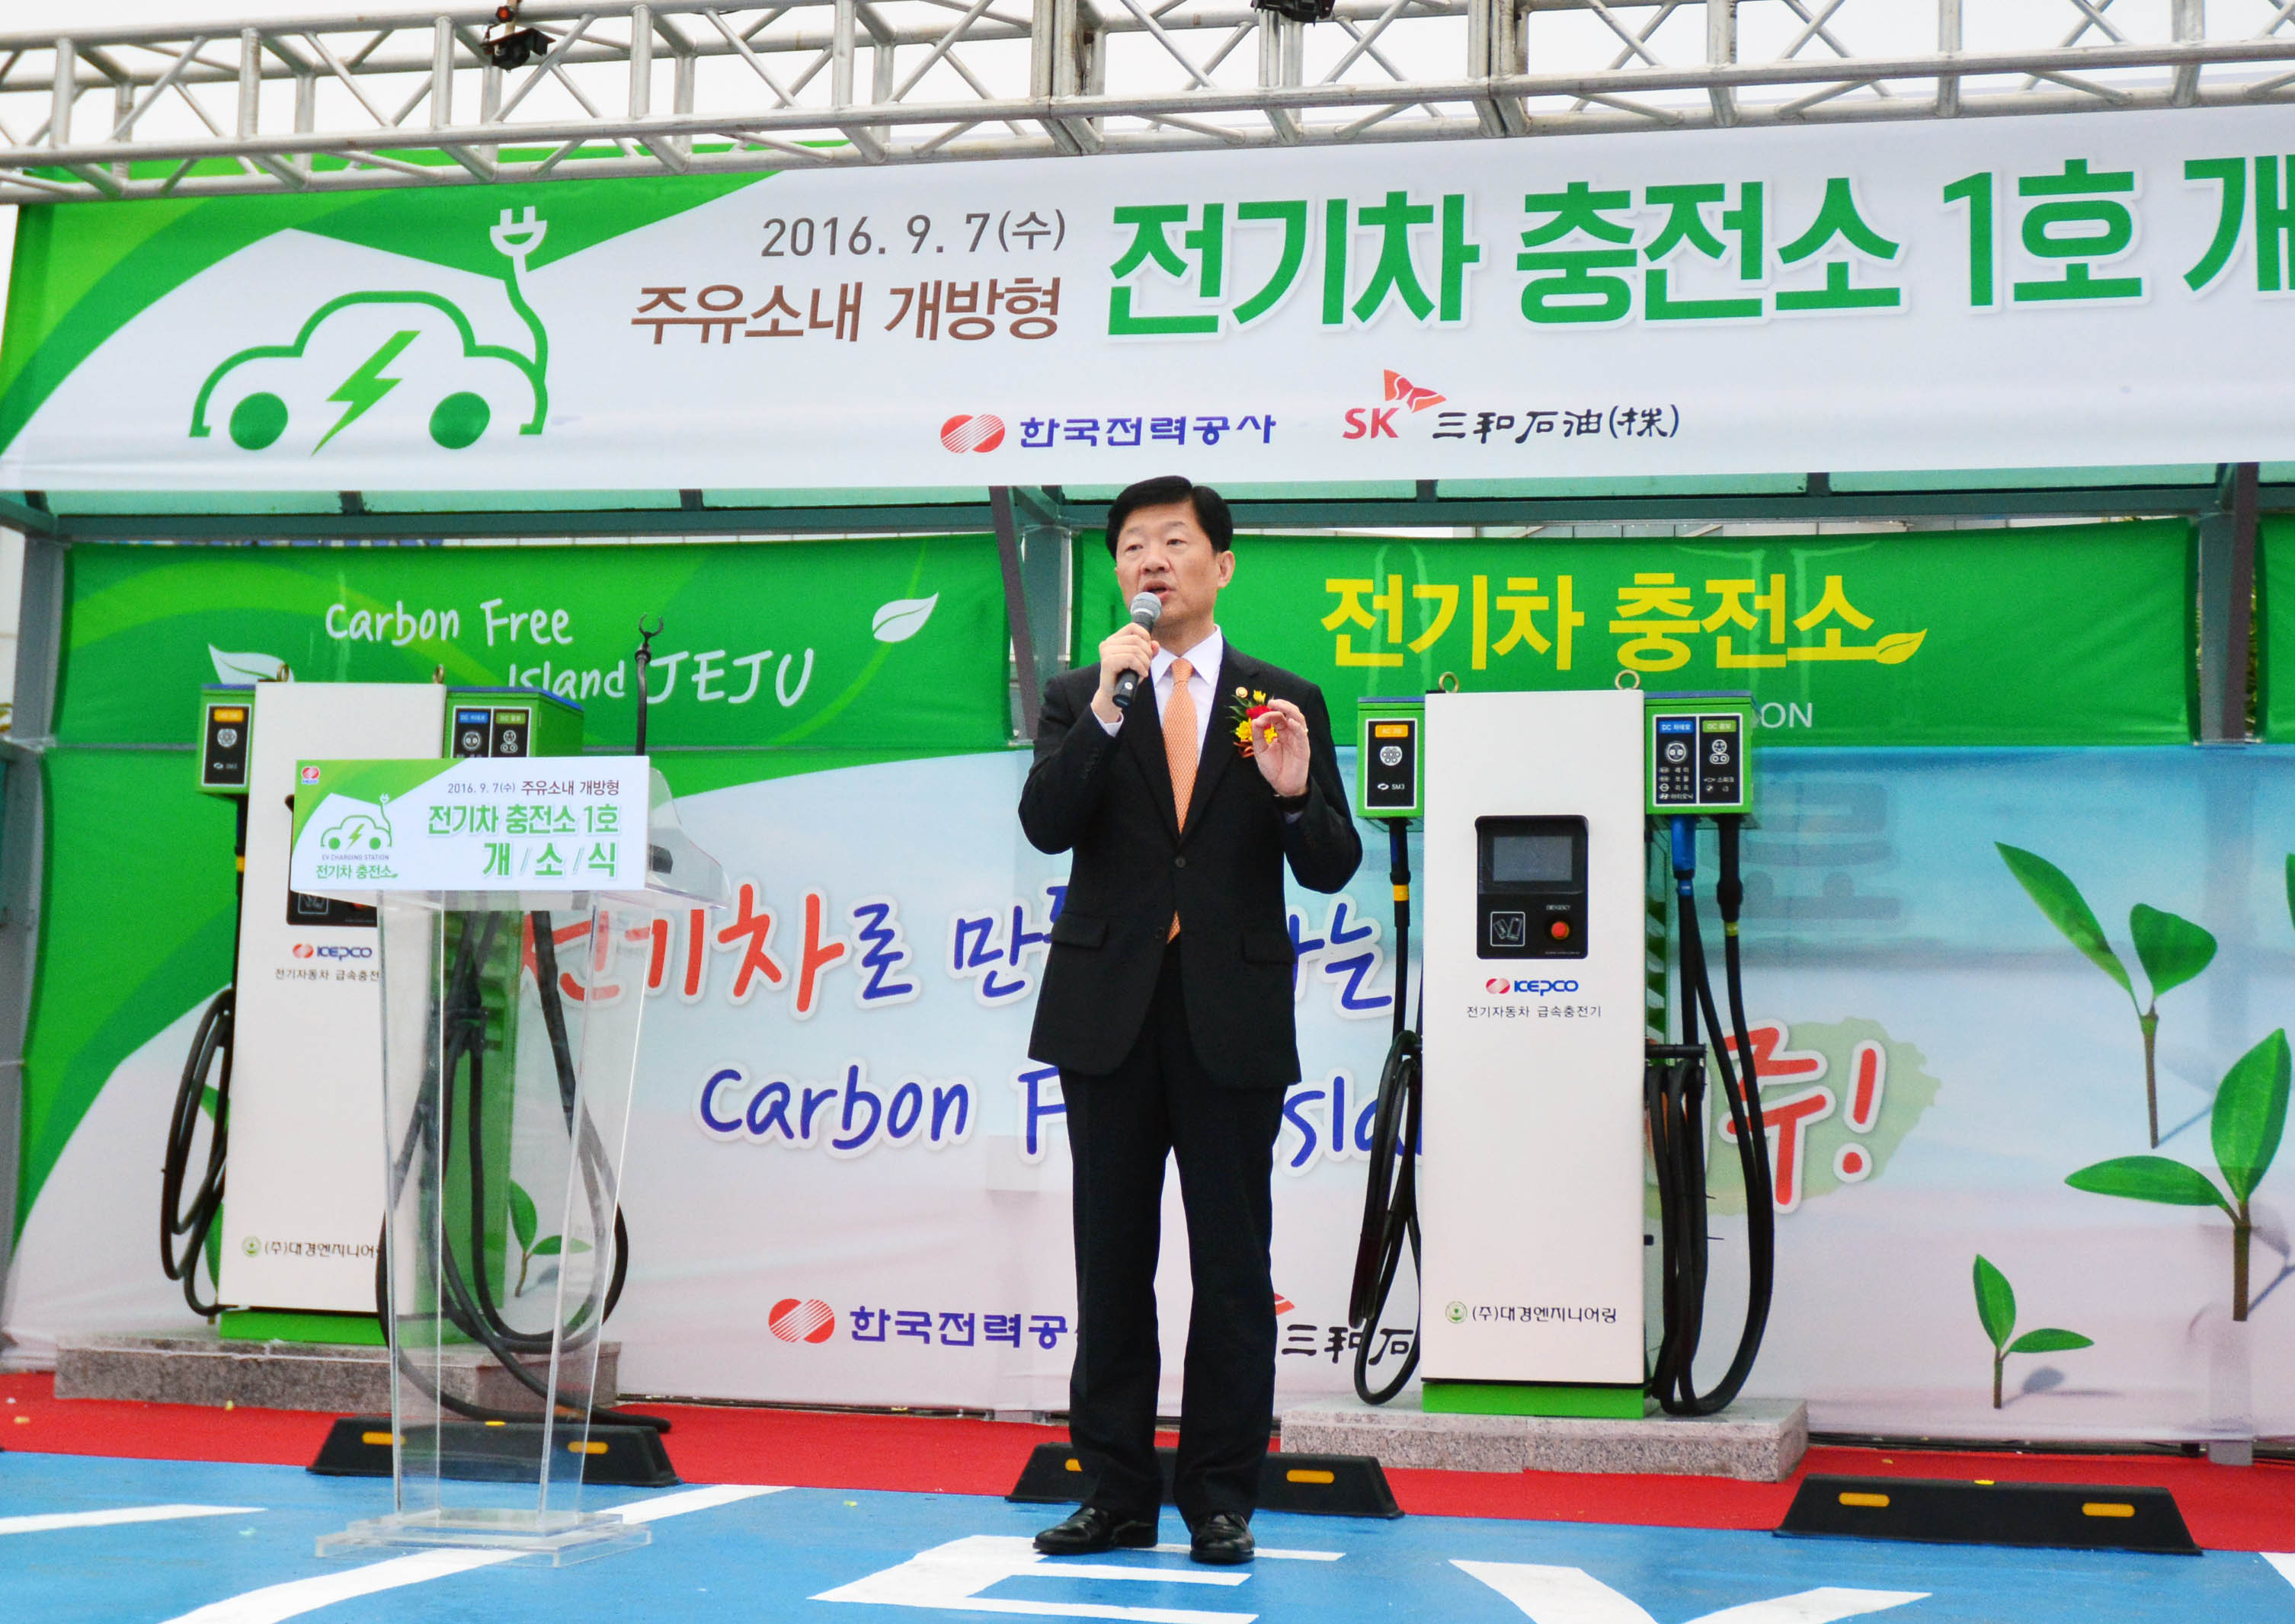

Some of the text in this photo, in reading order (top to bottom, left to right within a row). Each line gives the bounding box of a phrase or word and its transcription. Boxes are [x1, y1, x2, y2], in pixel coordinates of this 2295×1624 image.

[762, 209, 1065, 256] 2016. 9. 7(수)
[1109, 155, 2295, 335] 전기차 충전소 1호 개
[632, 277, 1060, 344] 주유소내 개방형
[1020, 415, 1276, 447] 한국전력공사
[1343, 408, 1399, 439] SK
[325, 599, 573, 646] Carbon Free
[1321, 573, 1886, 672] 전기차 충전소
[509, 647, 814, 707] Island JEJU
[448, 783, 476, 794] 2016.
[493, 782, 516, 794] 7(수)
[521, 781, 575, 796] 주유소내
[580, 780, 619, 796] 개방형
[428, 804, 619, 834] 전기차 충전소 1호
[316, 865, 393, 880] 전기차 충전소
[317, 946, 373, 961] KEPCO
[275, 968, 379, 982] 전기자동차 급속충전
[1514, 980, 1579, 996] KEPCO
[1467, 1005, 1601, 1018] 전기자동차 급속충전기
[700, 1064, 968, 1150] Carbon
[264, 1242, 379, 1258] (주)대경엔지니어
[850, 1305, 1077, 1350] 한국전력공
[1472, 1306, 1616, 1324] (주)대경엔지니어링
